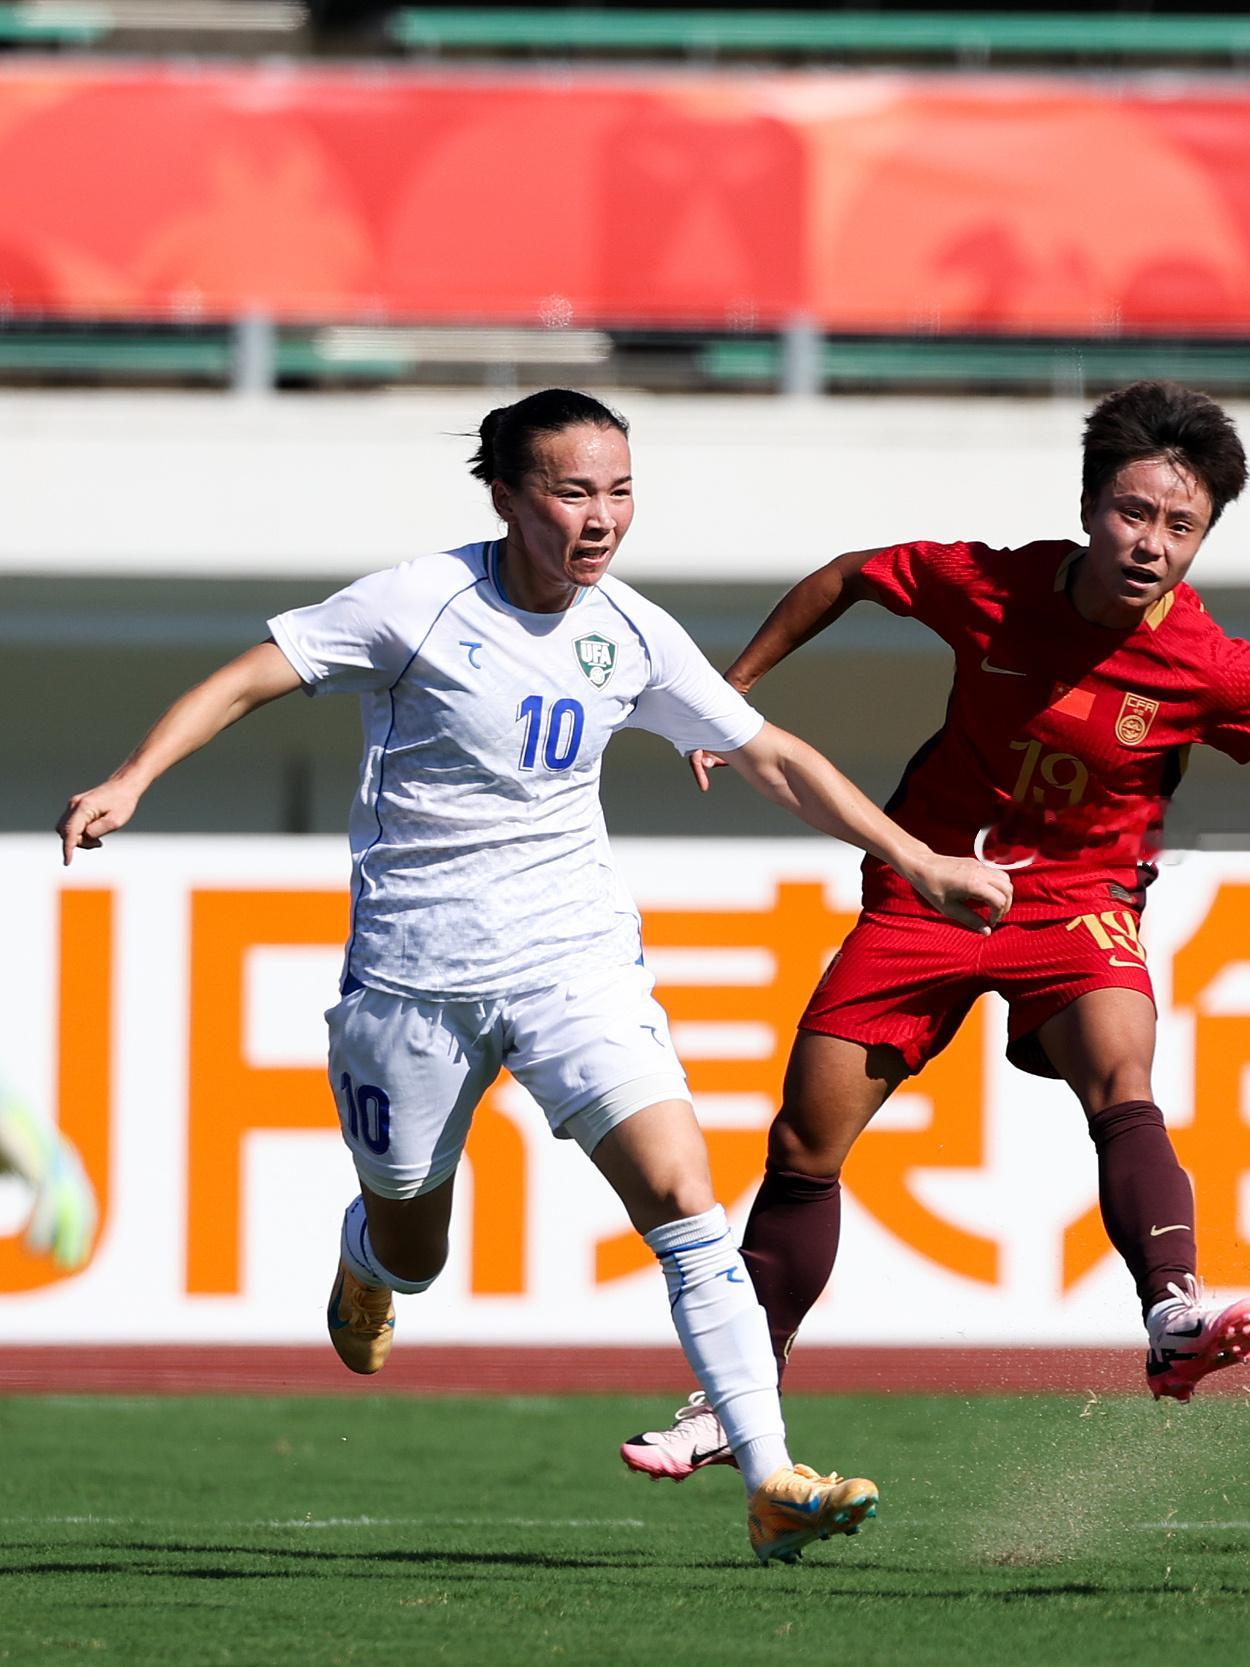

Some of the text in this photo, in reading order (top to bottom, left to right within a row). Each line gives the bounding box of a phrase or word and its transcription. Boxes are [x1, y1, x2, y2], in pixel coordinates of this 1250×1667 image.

[580, 640, 612, 666] UFA
[516, 695, 585, 772] 10
[1127, 696, 1155, 713] CFA
[1009, 739, 1089, 806] 19
[1065, 910, 1146, 962] 19
[341, 1072, 390, 1155] 10
